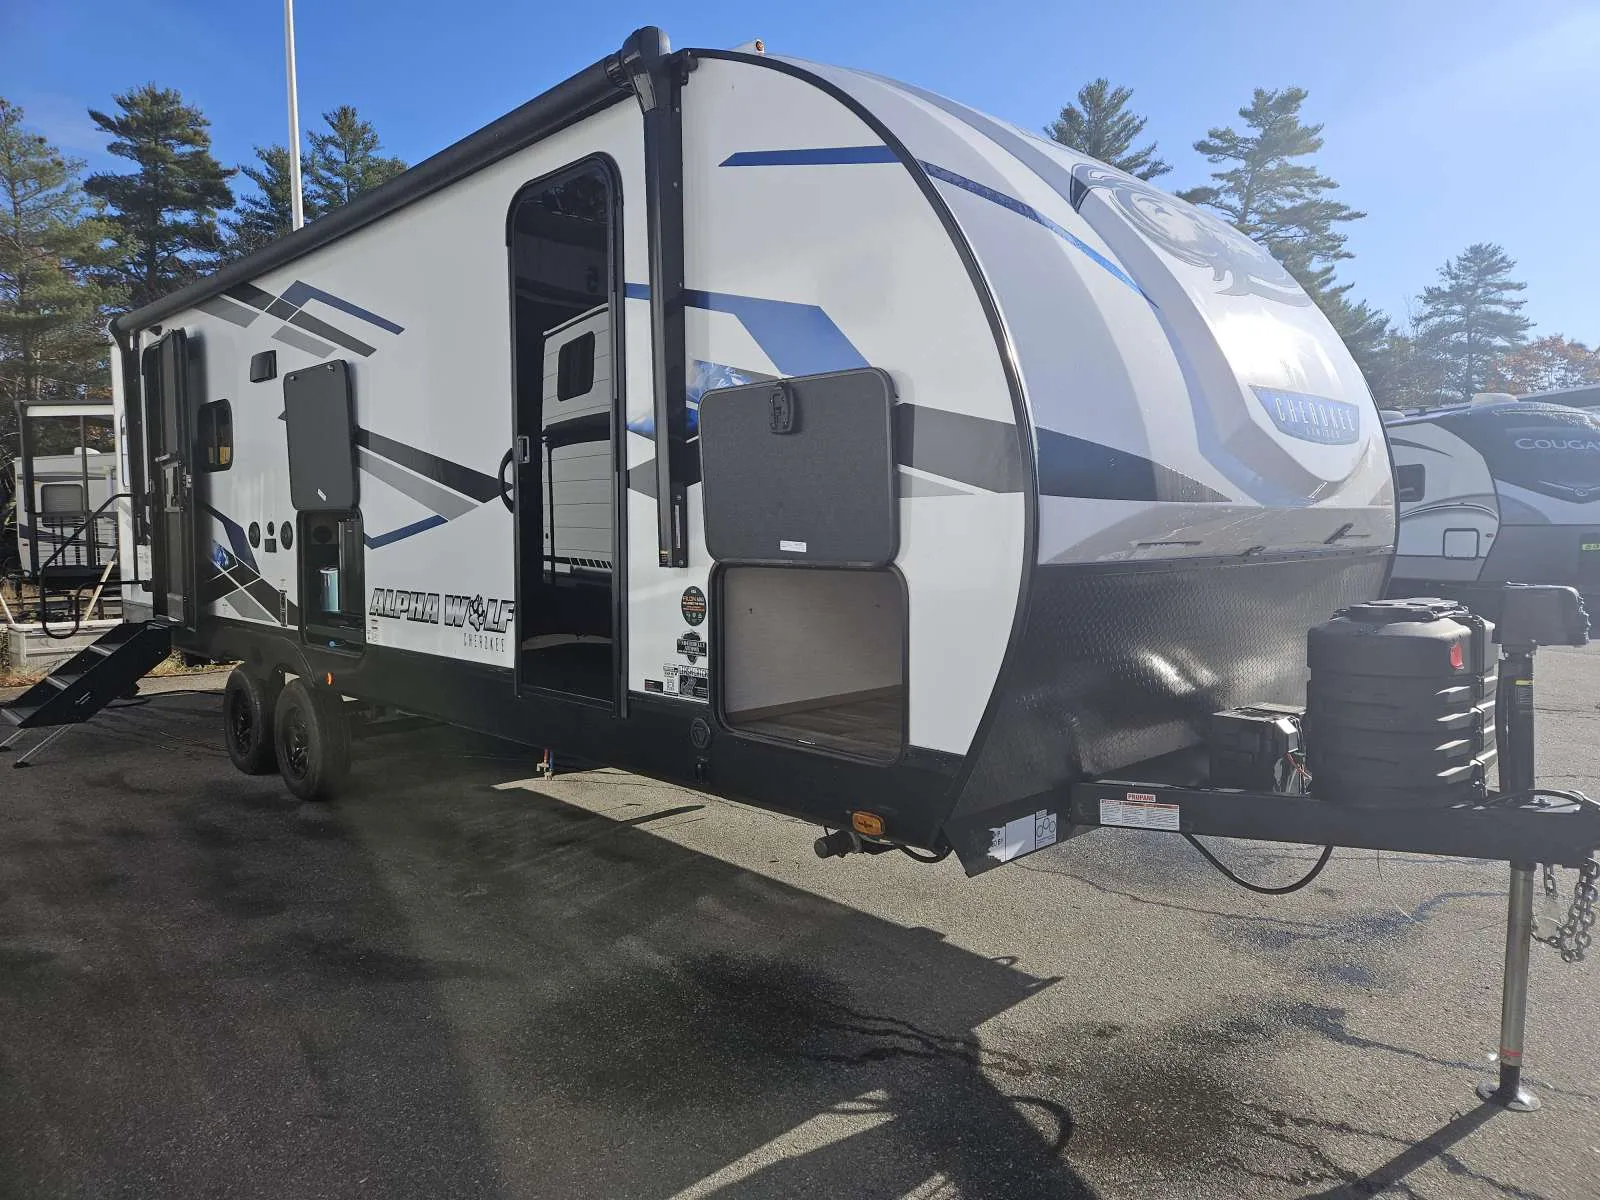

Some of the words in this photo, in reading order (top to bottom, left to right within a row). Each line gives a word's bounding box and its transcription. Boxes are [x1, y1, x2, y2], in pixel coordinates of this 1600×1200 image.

[1515, 437, 1600, 451] COUGA
[369, 587, 440, 625] ALPHA
[1127, 793, 1155, 802] PROPANE
